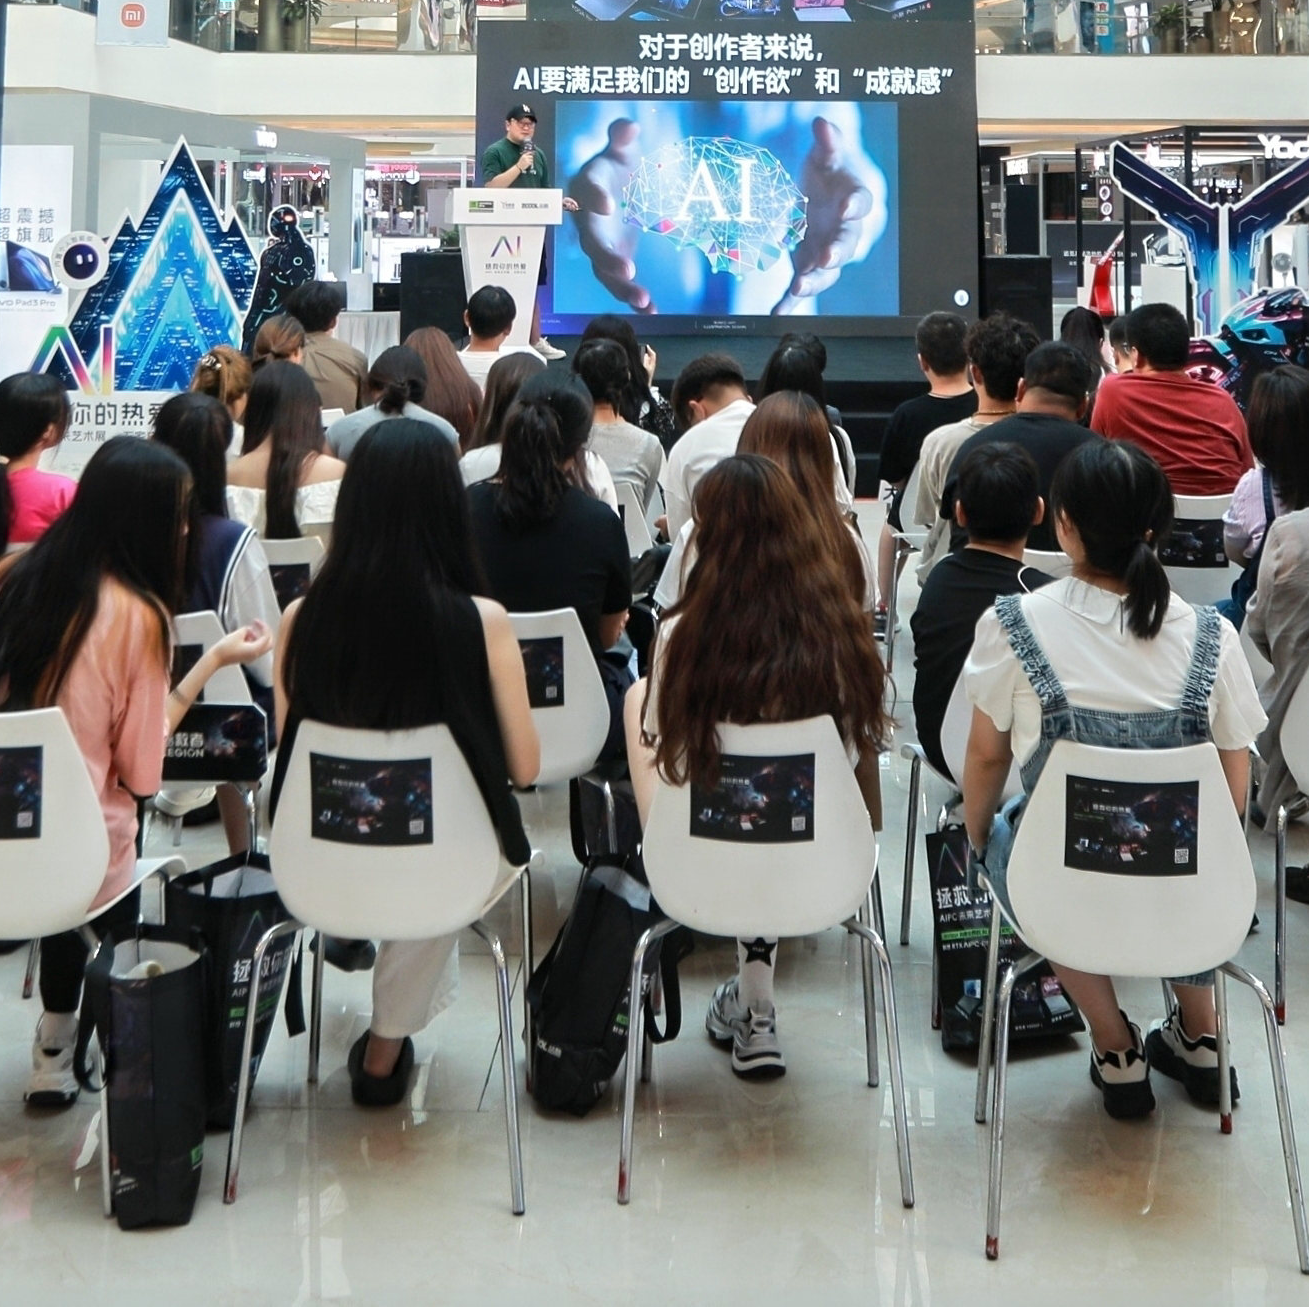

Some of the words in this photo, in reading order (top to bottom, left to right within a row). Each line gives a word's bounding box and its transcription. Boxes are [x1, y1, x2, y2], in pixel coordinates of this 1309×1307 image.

[677, 157, 759, 223] AI
[490, 235, 521, 258] AI
[15, 299, 39, 307] Pad3
[40, 299, 56, 307] Pro
